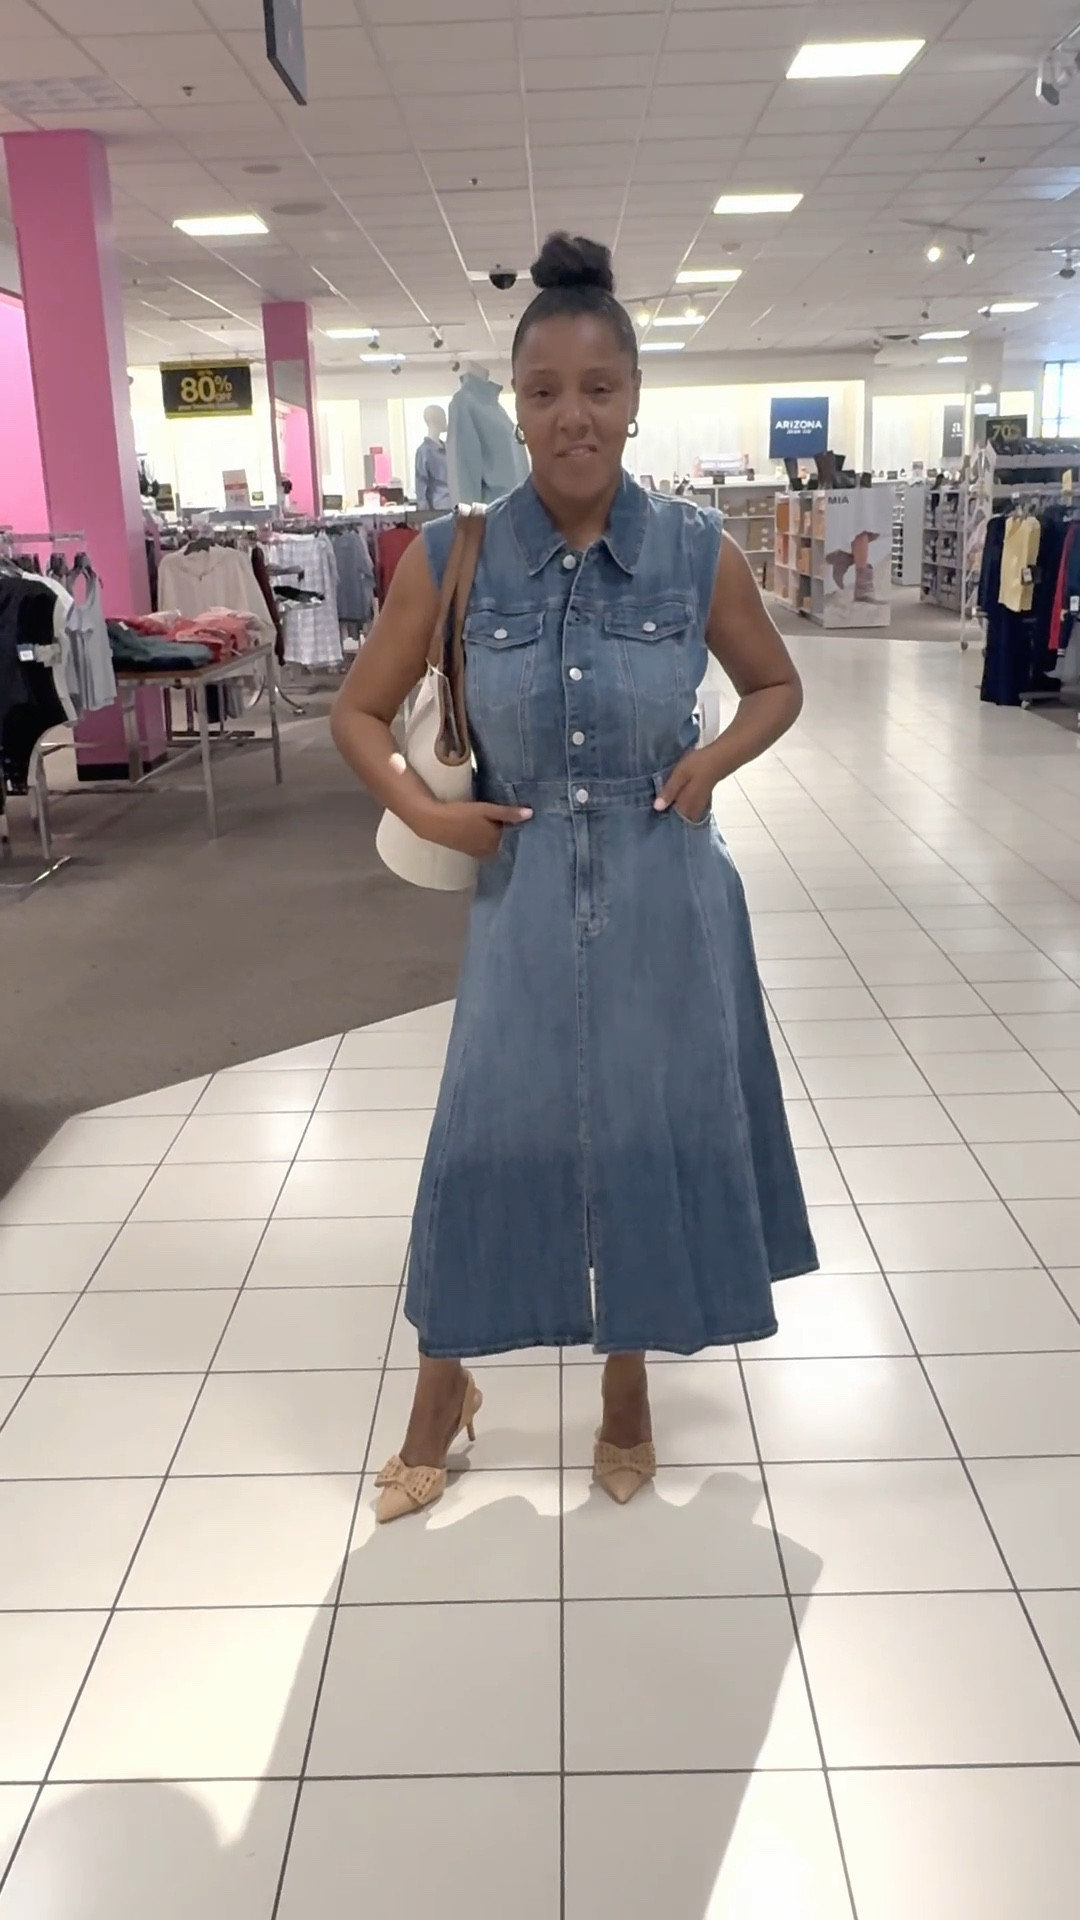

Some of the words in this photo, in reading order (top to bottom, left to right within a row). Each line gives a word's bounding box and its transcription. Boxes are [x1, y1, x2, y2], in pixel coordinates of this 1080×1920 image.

[181, 375, 232, 403] 80%
[775, 420, 822, 430] ARIZONA
[828, 496, 849, 504] MIA
